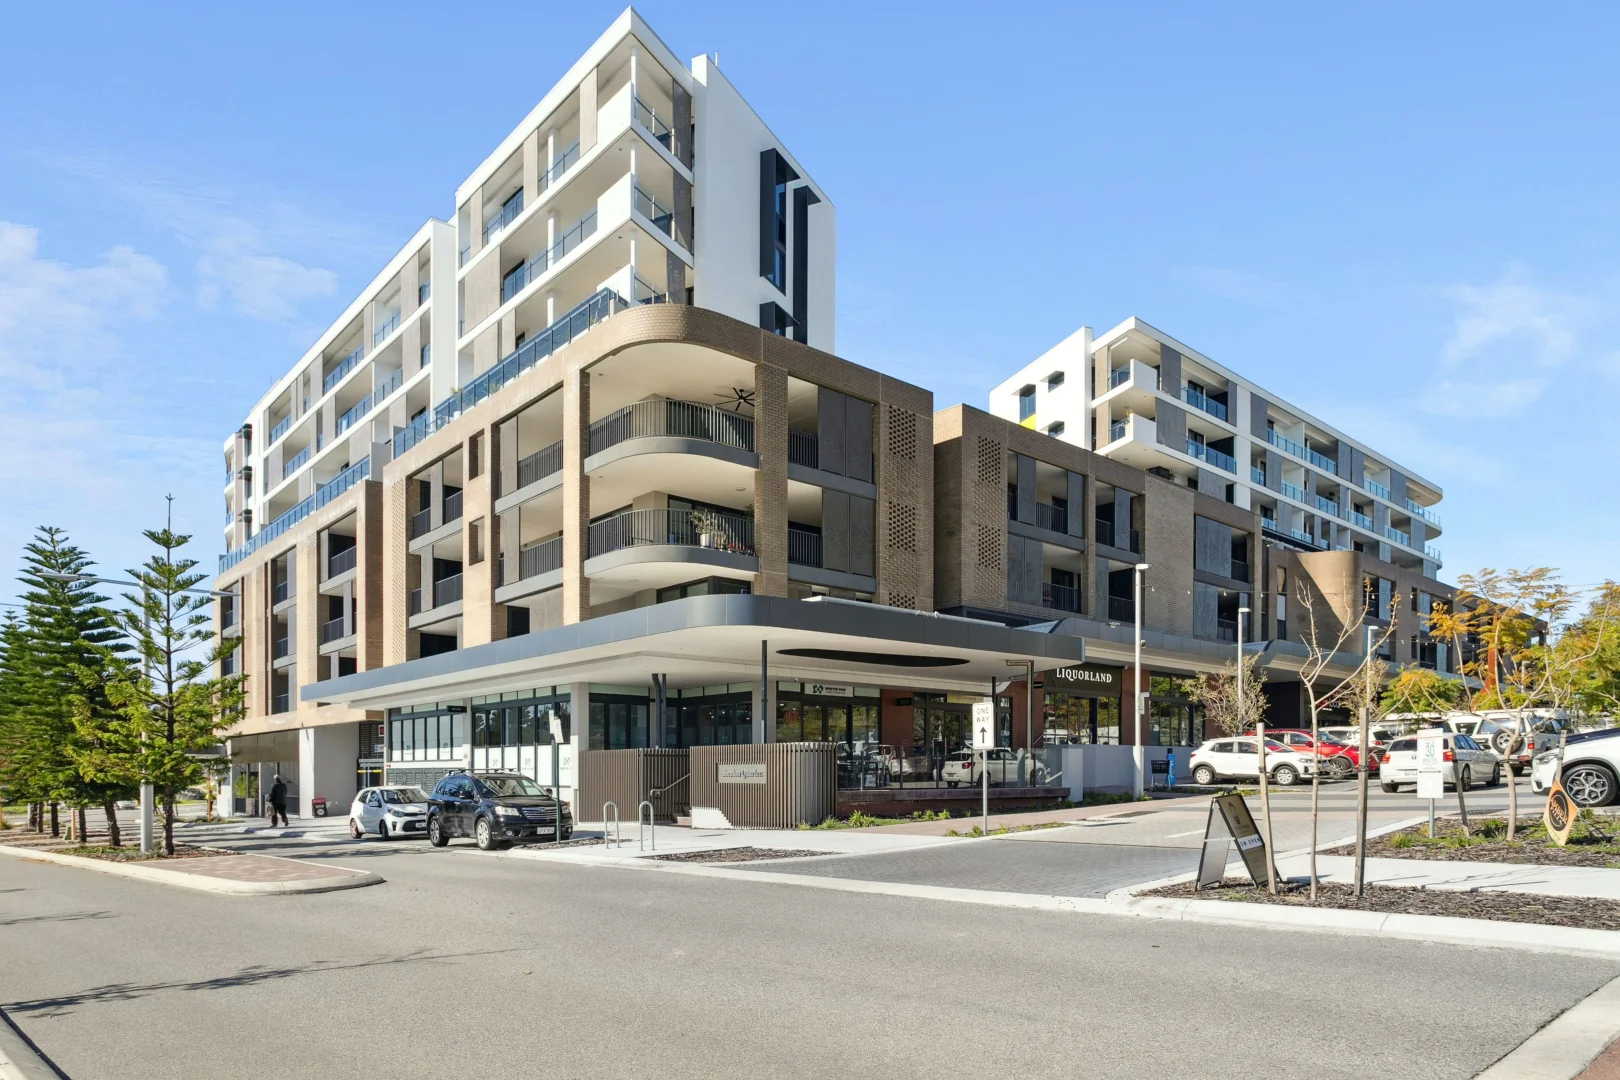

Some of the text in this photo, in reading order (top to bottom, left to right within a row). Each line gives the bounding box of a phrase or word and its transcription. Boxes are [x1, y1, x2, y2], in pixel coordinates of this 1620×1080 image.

[1056, 668, 1112, 683] LIQUORLAND
[976, 706, 989, 715] ONE
[1425, 744, 1435, 758] 30
